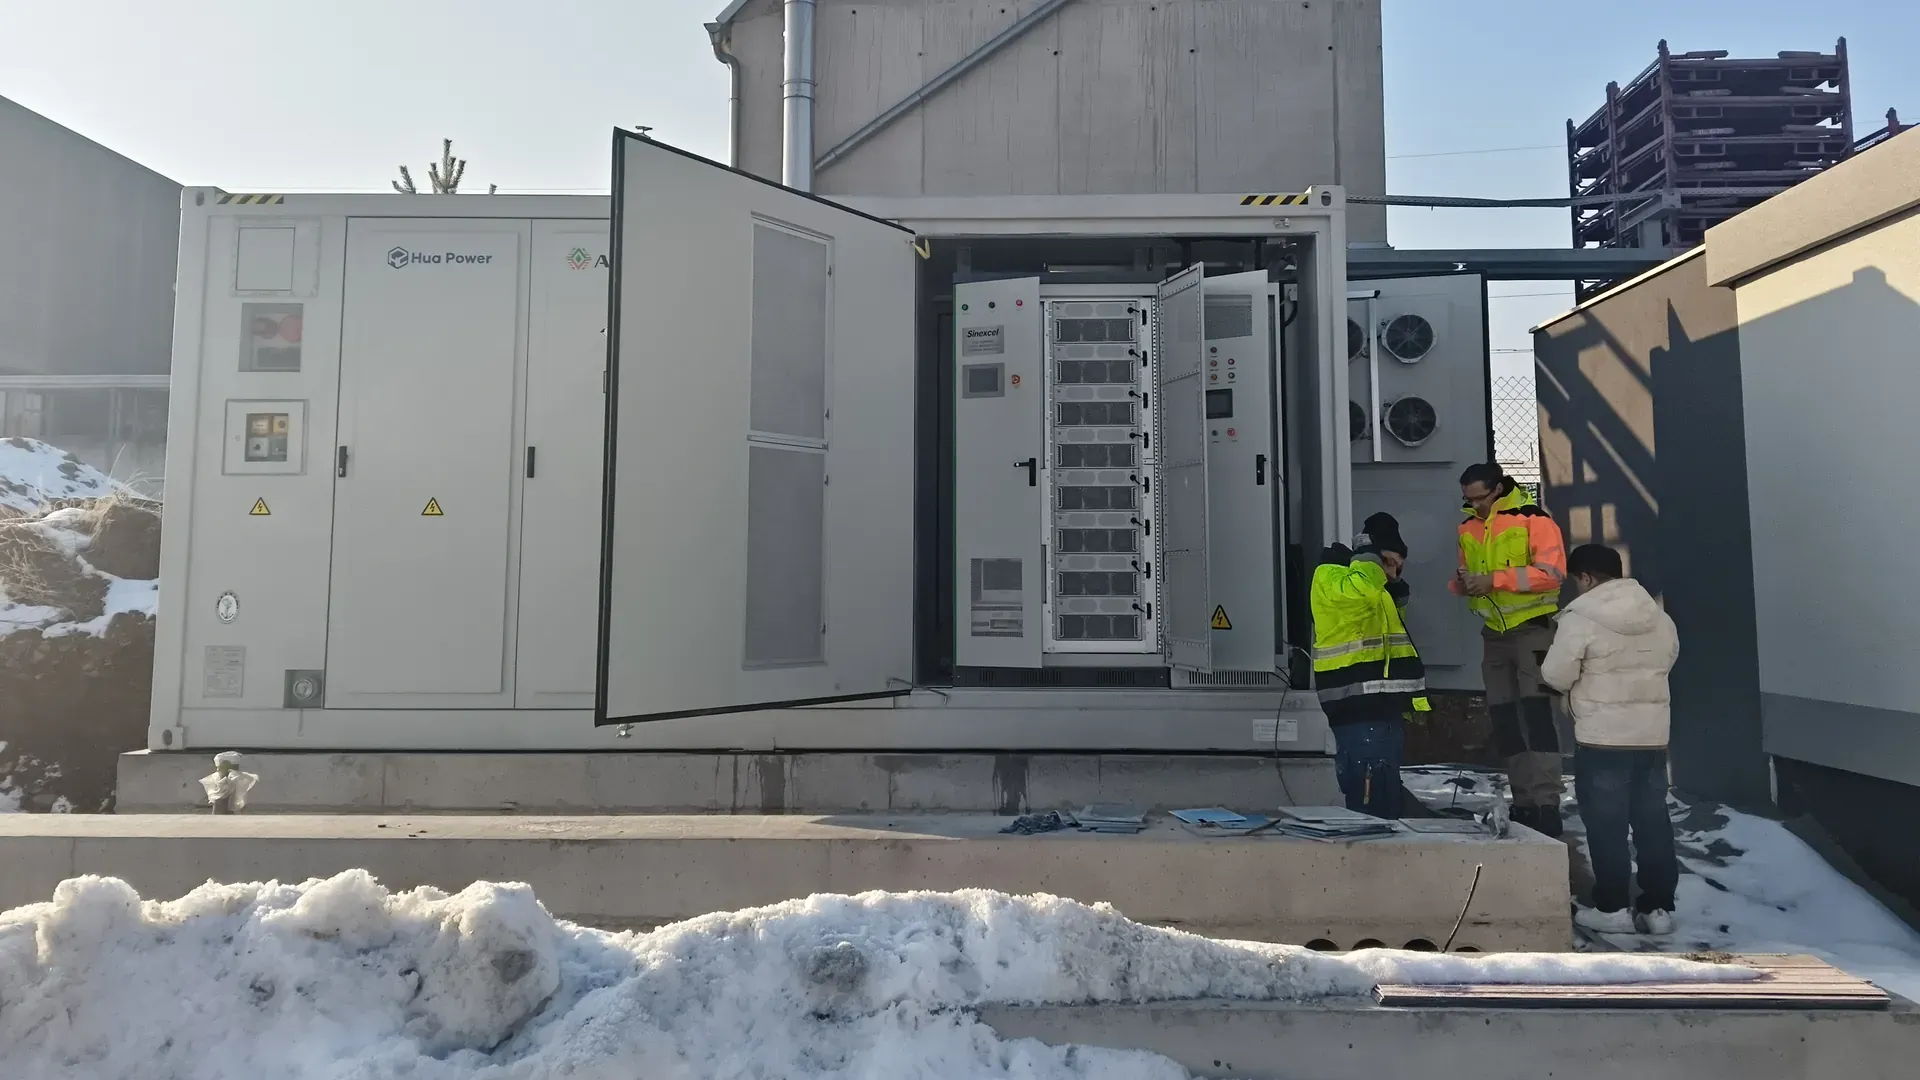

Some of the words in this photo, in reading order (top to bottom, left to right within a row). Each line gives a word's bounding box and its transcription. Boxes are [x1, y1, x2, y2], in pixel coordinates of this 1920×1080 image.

[411, 252, 441, 264] Hua
[445, 252, 492, 264] Power
[967, 328, 999, 338] Sinexcel
